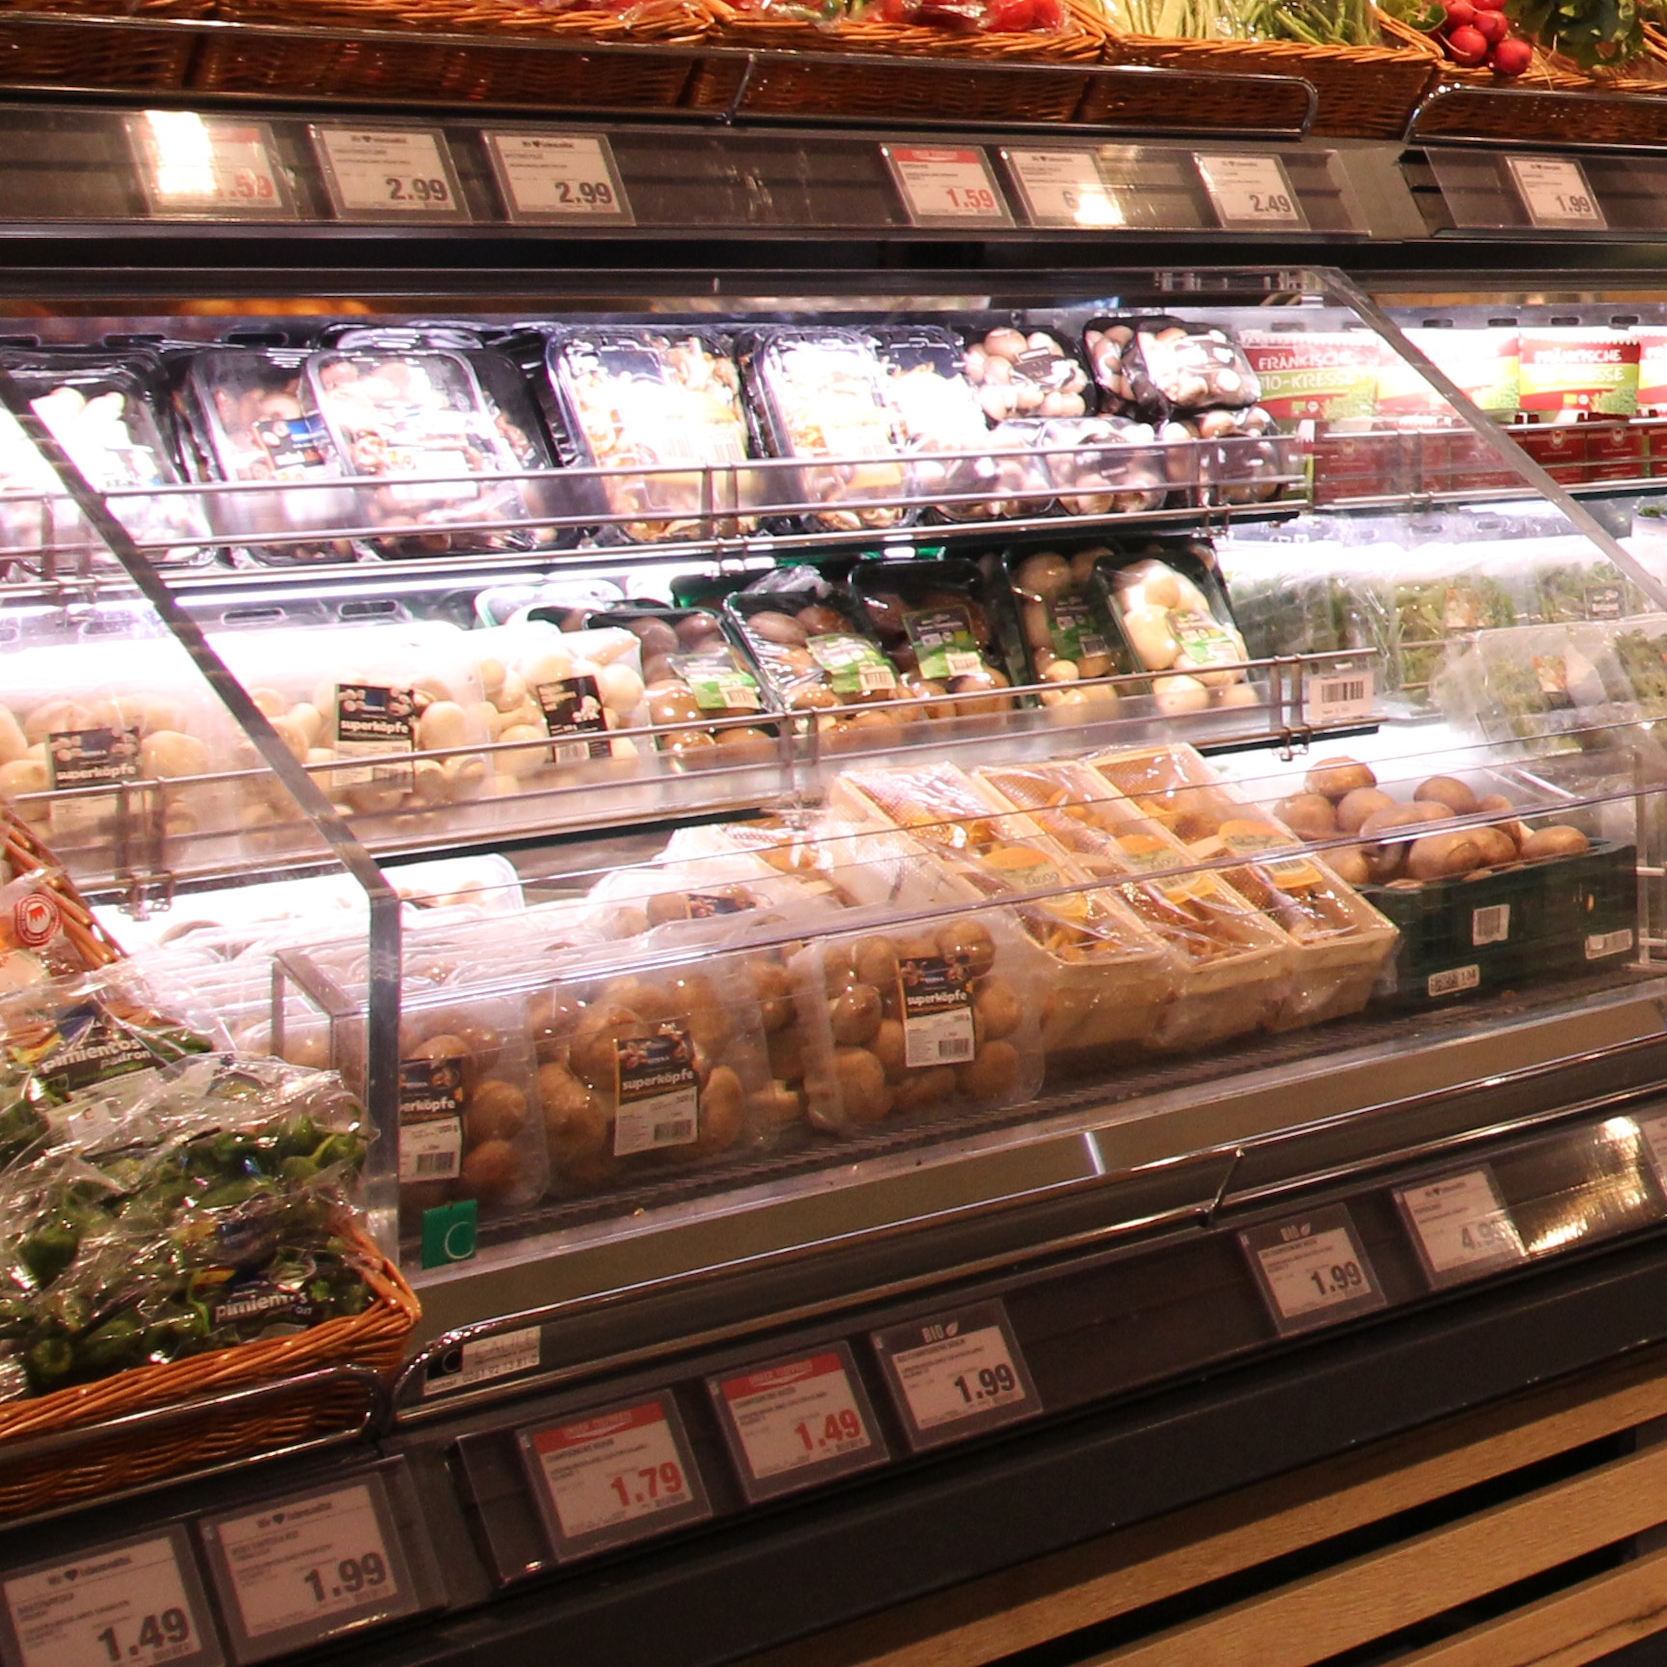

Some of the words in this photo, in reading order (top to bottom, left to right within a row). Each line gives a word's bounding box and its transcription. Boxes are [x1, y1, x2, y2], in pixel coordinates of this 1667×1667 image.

[386, 177, 450, 202] 2.99
[554, 181, 612, 205] 2.99
[946, 187, 995, 209] 1.59
[1250, 194, 1291, 213] 2.49
[1555, 194, 1592, 214] 1.99
[339, 718, 411, 737] superköpfe
[55, 761, 137, 782] superköpfe
[906, 989, 968, 1007] superköpfe
[622, 1068, 695, 1091] superköpfe
[400, 1097, 456, 1114] erköpfe
[1311, 1261, 1362, 1296] 1.99
[921, 1324, 944, 1344] BIO
[954, 1363, 1016, 1404] 1.99
[794, 1408, 862, 1452] 1.49
[611, 1461, 683, 1507] 1.79
[305, 1551, 388, 1604] 1.99
[98, 1607, 191, 1663] 1.49
